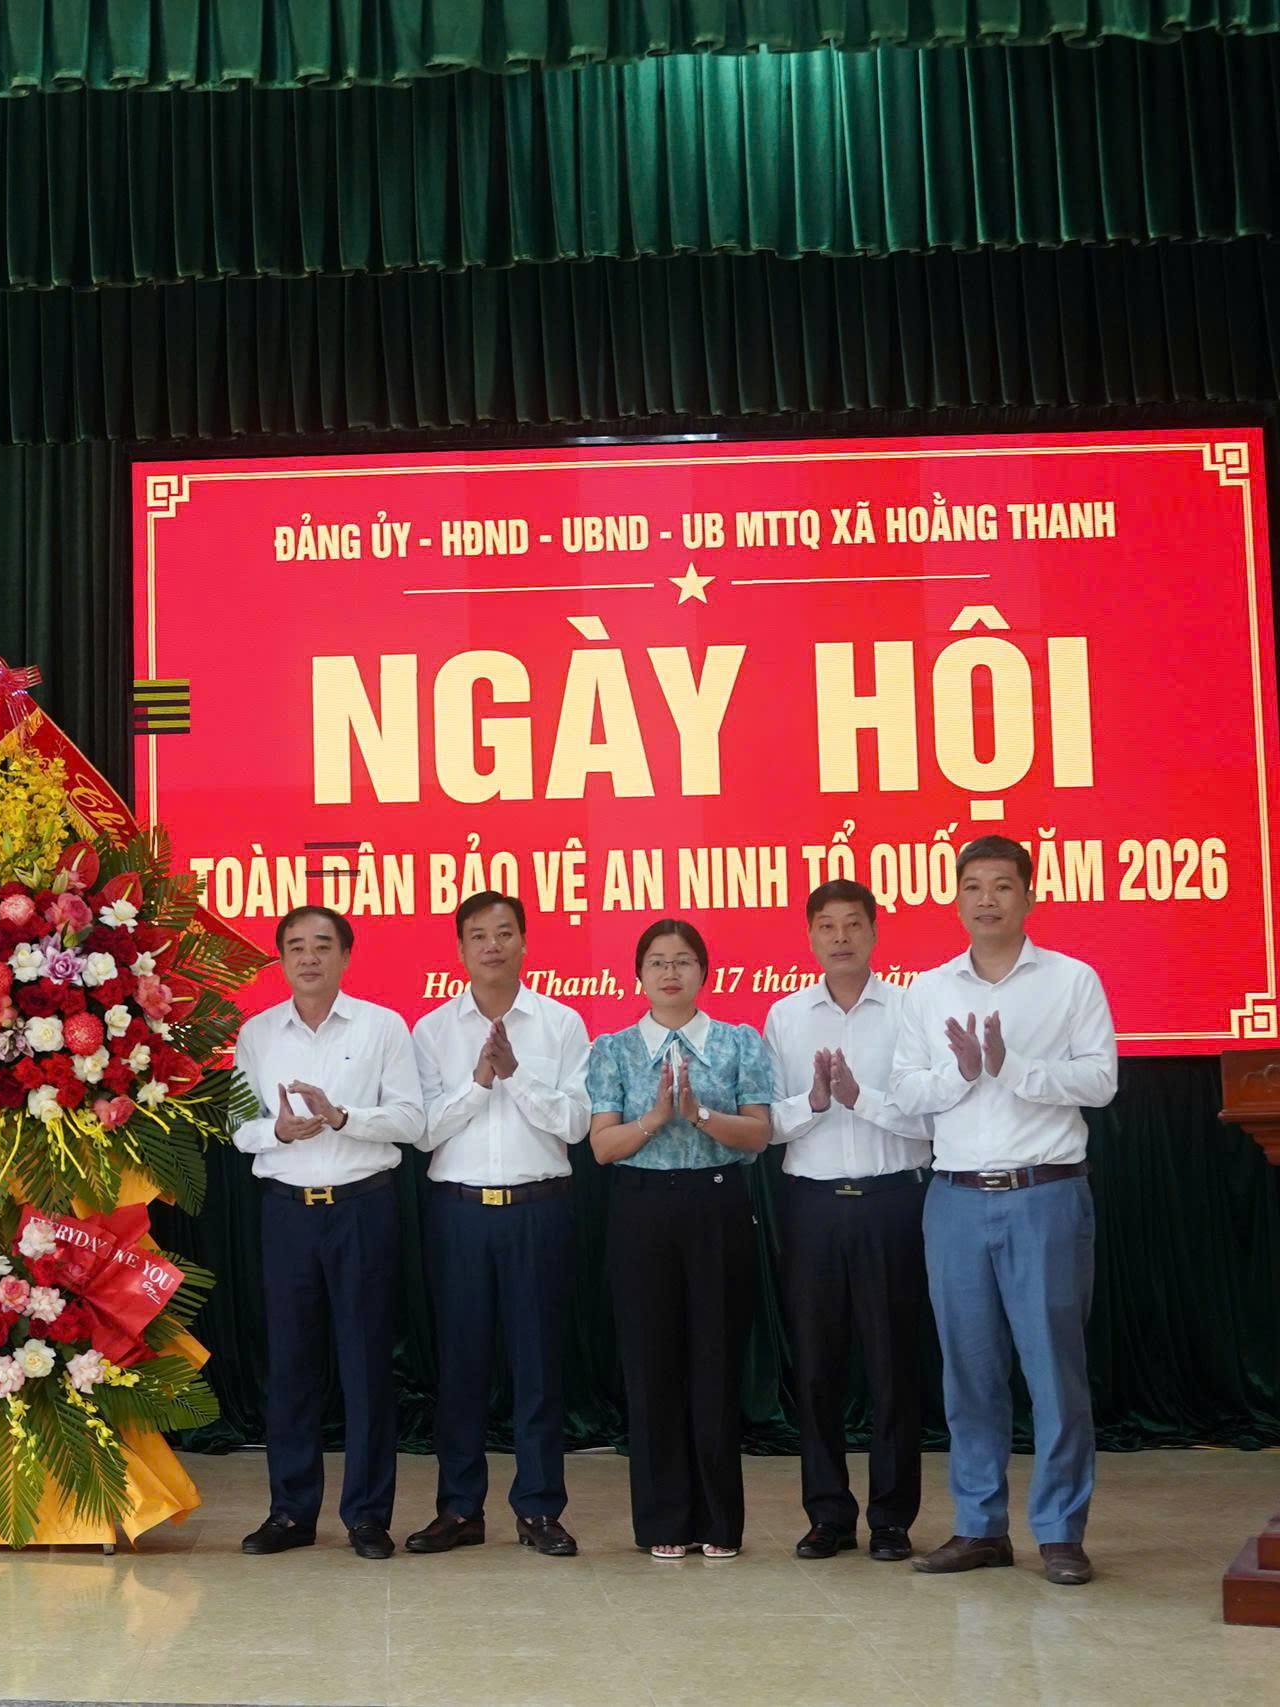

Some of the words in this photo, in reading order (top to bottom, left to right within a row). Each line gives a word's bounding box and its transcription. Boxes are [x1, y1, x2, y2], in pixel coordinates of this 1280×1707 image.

[274, 513, 361, 562] ĐẢNG
[371, 510, 411, 558] ỦY
[441, 519, 529, 557] HĐND
[562, 515, 649, 554] UBND
[683, 512, 725, 549] UB
[736, 508, 820, 550] MTTQ
[831, 500, 875, 545] XÃ
[886, 491, 998, 542] HOẰNG
[1007, 501, 1116, 540] THANH
[312, 615, 746, 804] NGÀY
[815, 605, 1094, 821] HỘI
[190, 843, 308, 918] TOÀN
[322, 841, 415, 916] DÂN
[429, 832, 520, 917] BẢO
[533, 836, 590, 926] VỆ
[602, 849, 667, 911] AN
[680, 846, 788, 910] NINH
[801, 819, 856, 895] TỔ
[870, 822, 972, 913] QUỐ
[1021, 826, 1105, 902] ĂM
[1118, 836, 1229, 902] 2026
[526, 968, 625, 1000] Thanh,
[711, 966, 745, 994] 17
[29, 1216, 109, 1253] RYDAY
[141, 1260, 175, 1292] YOU
